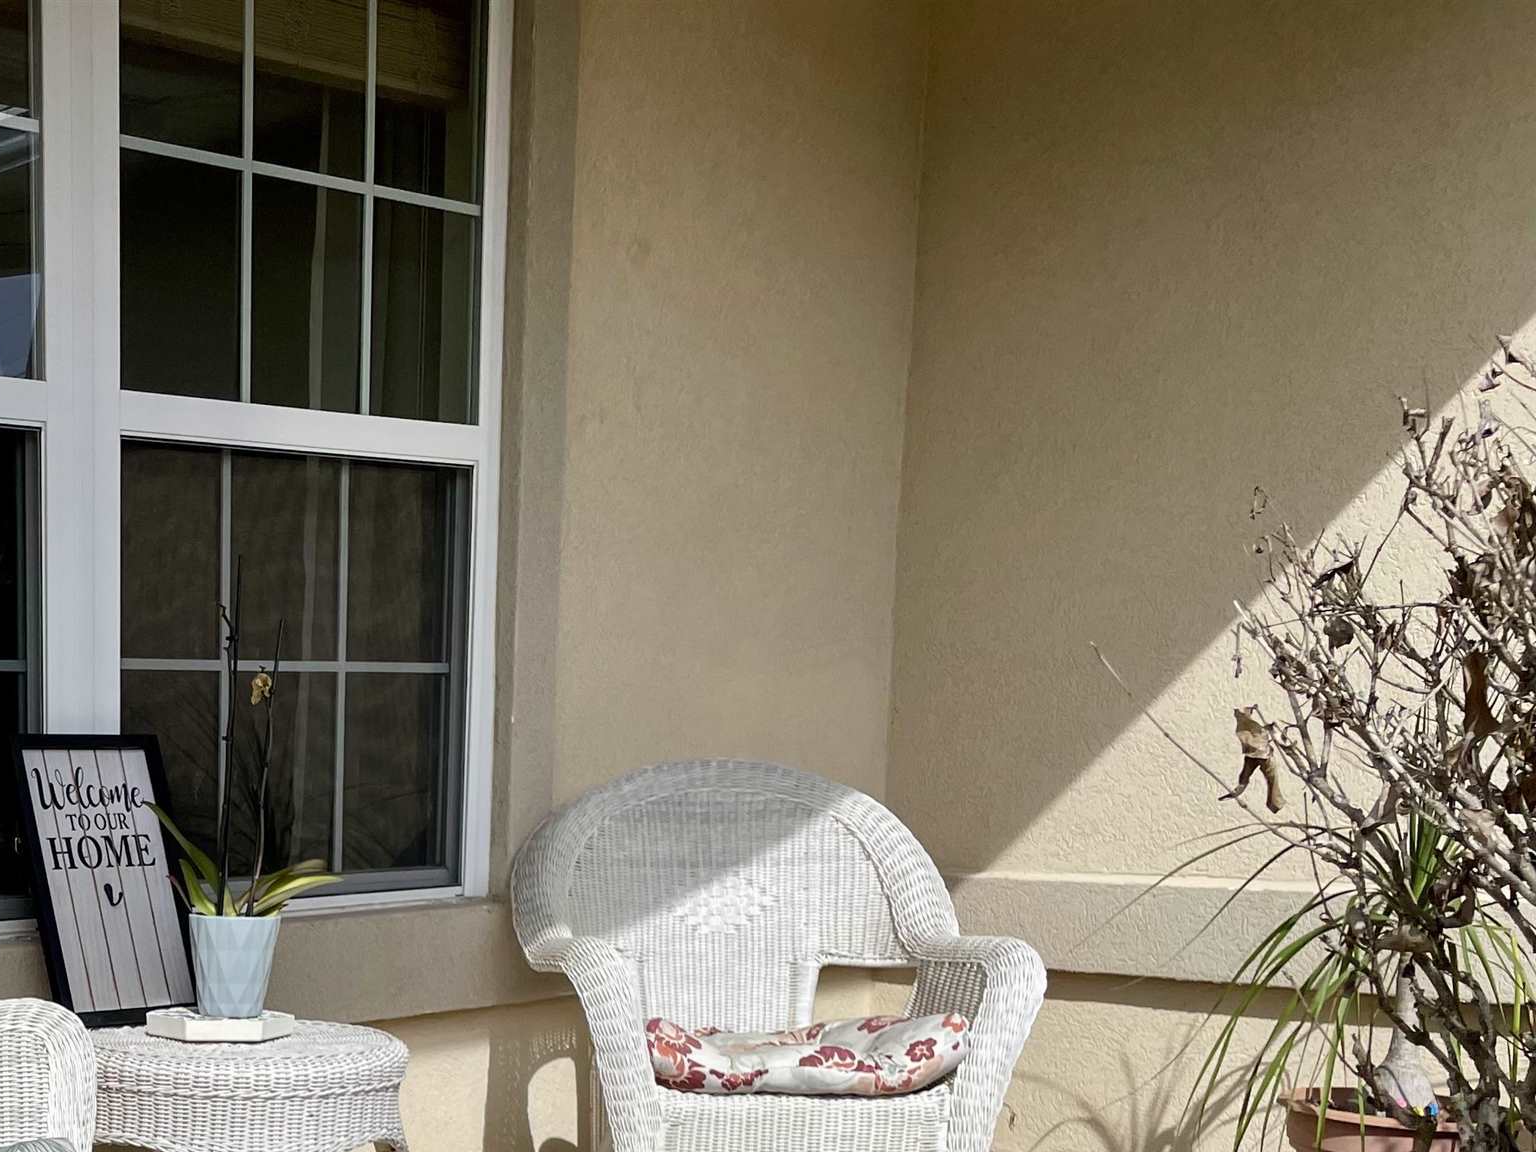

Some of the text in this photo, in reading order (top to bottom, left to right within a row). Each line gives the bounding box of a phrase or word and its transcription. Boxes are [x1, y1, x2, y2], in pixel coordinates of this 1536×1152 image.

[30, 766, 146, 812] Welcome
[65, 812, 129, 831] TO OUR
[46, 834, 156, 870] HOME
